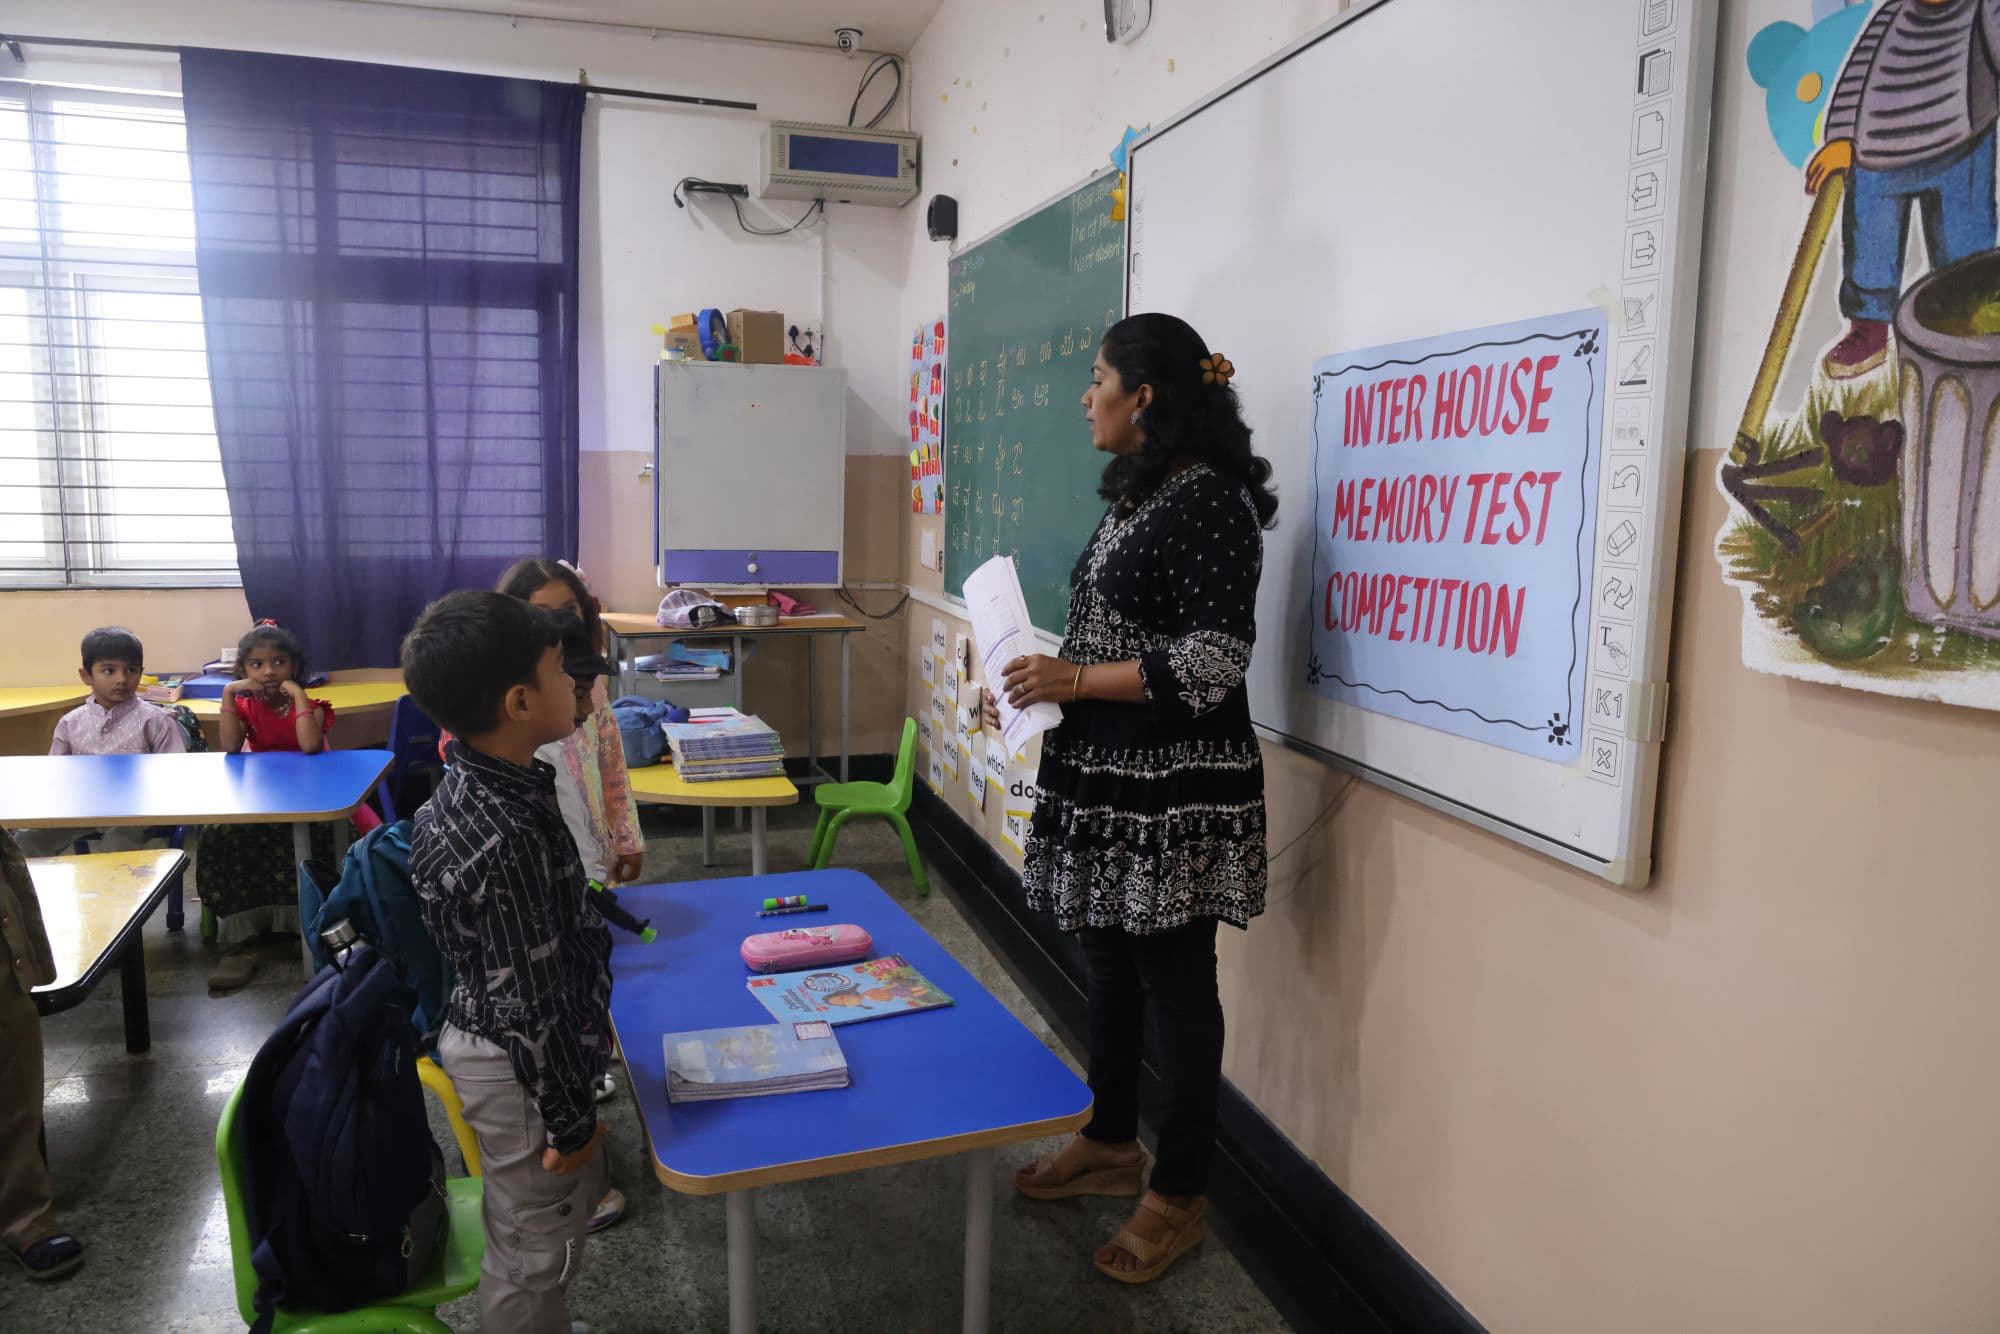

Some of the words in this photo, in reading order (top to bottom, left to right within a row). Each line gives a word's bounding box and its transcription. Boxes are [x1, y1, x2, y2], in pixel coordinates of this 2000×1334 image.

[1343, 374, 1427, 448] INTER
[1431, 354, 1560, 440] HOUSE
[1332, 473, 1460, 543] MEMORY
[1463, 471, 1562, 546] TEST
[1324, 571, 1526, 659] COMPETITION
[946, 671, 956, 690] take
[933, 696, 945, 715] where
[1595, 688, 1624, 720] K1
[944, 740, 957, 760] which
[987, 753, 1004, 776] which
[971, 768, 983, 792] here
